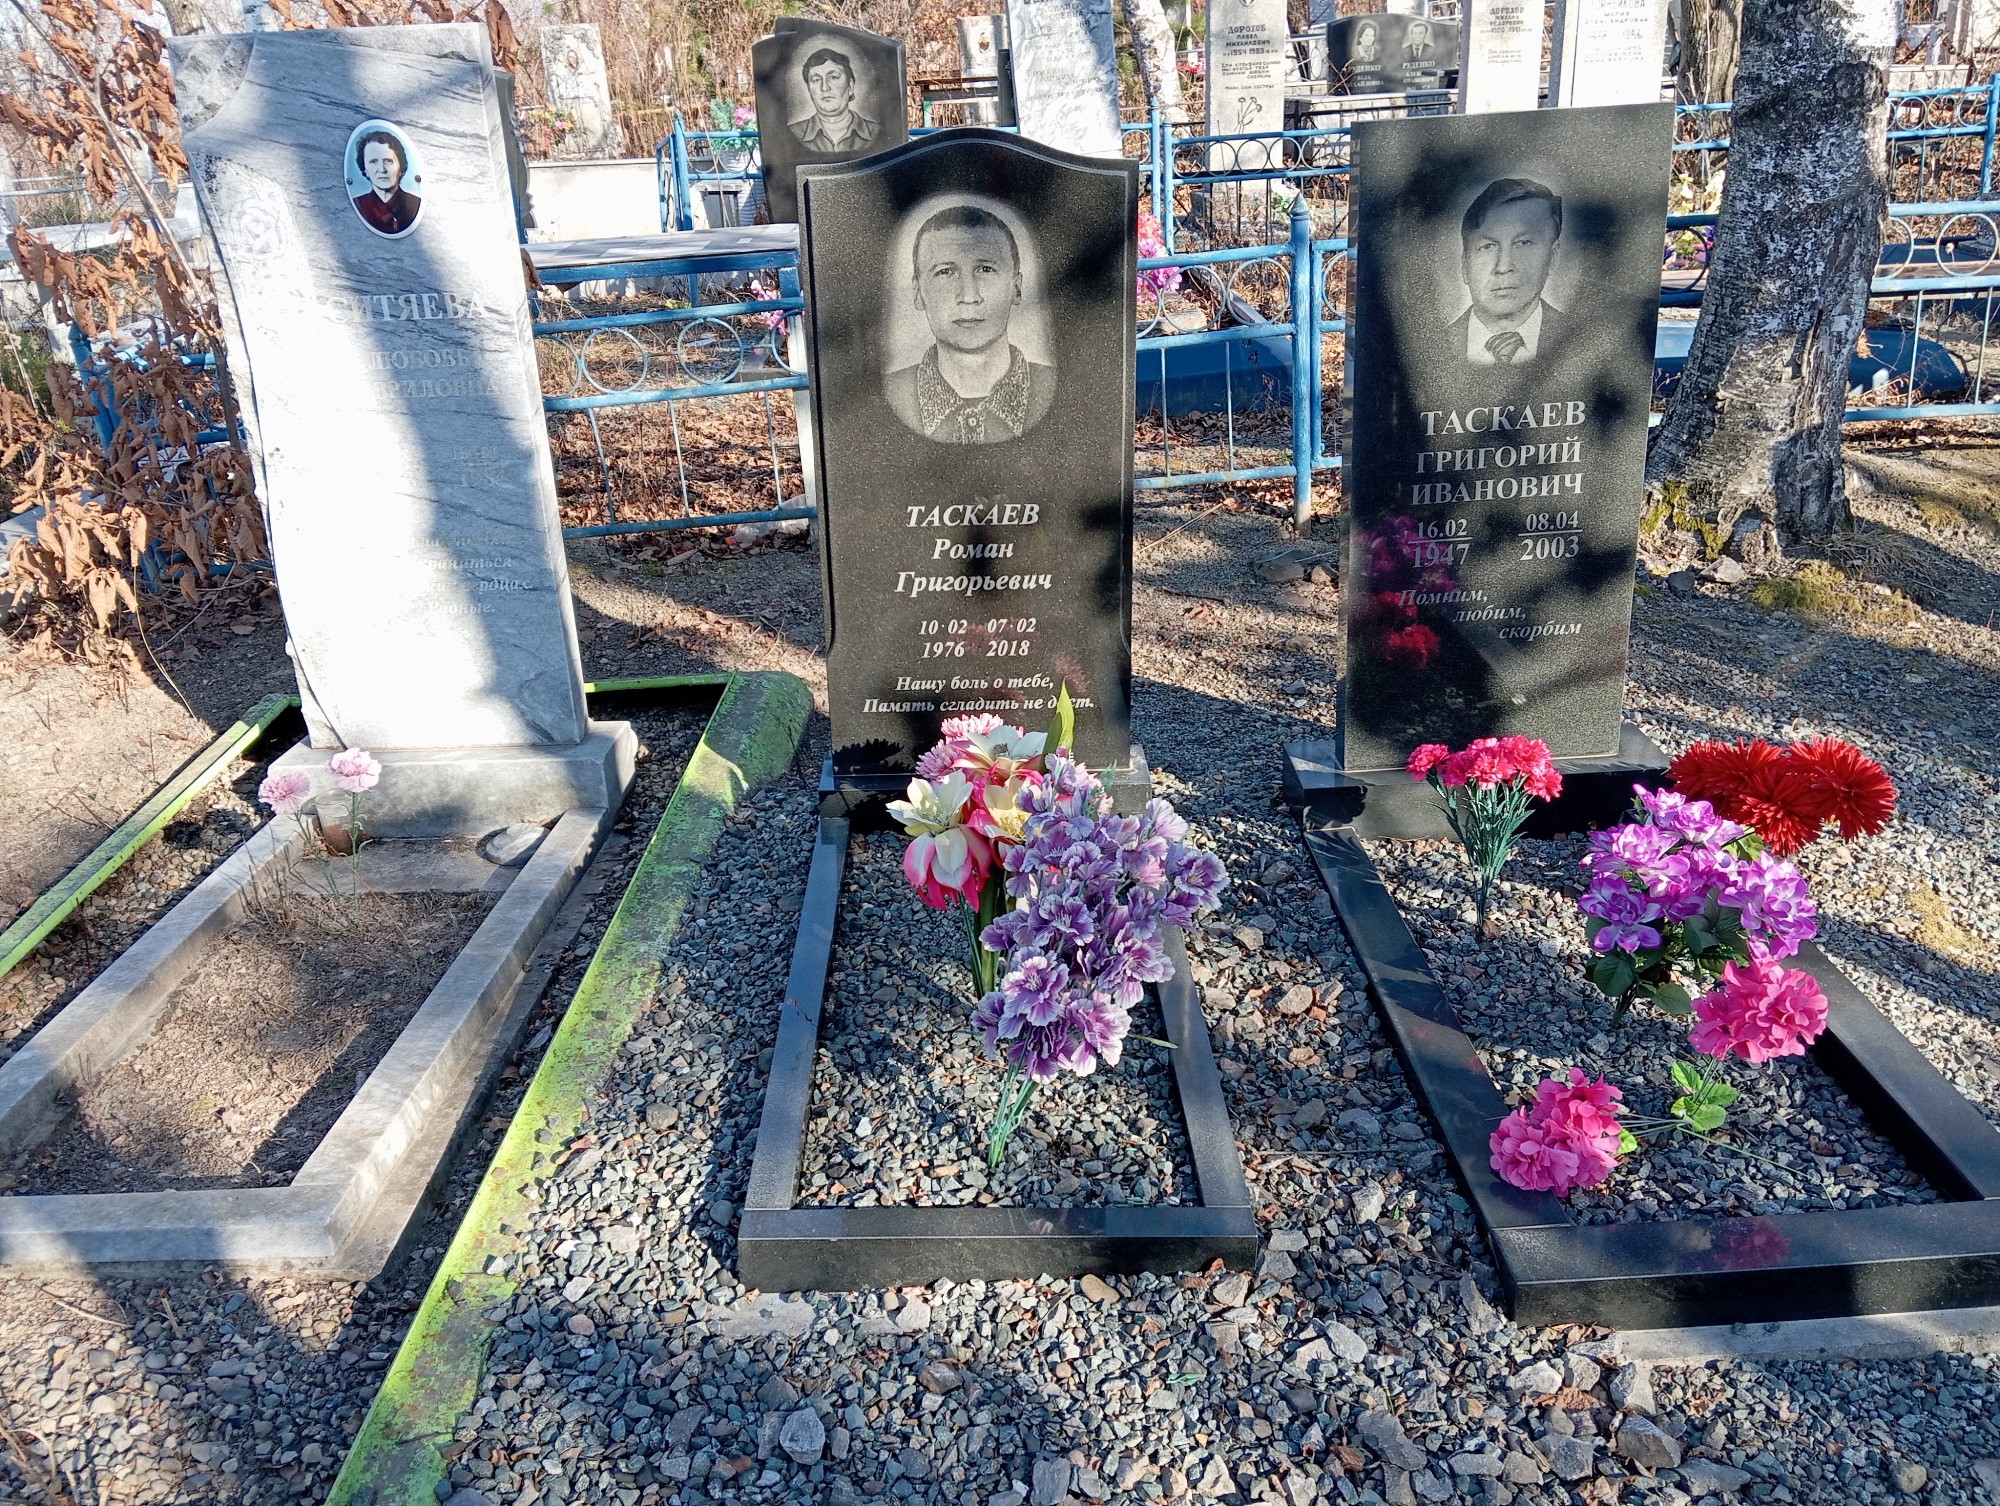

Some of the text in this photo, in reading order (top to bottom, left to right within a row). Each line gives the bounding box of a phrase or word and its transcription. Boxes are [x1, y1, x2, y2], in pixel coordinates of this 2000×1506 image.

[1228, 25, 1266, 35] ДОРОХОВ
[1402, 61, 1435, 69] РУДЕНКО
[326, 291, 492, 324] СИТЯЕВА
[370, 349, 468, 370] ЛЮБОВЬ
[1420, 400, 1586, 436] ТАСКАЕВ
[1415, 435, 1583, 474] ГРИГОРИЙ
[1410, 472, 1586, 506] ИВАНОВИЧ
[906, 503, 1040, 528] ТАСКАЕВ
[1416, 511, 1580, 539] 16.02 08.04
[931, 538, 1014, 560] Роман
[1412, 535, 1580, 568] 1947 2003
[894, 571, 1053, 598] Григорьевич
[1398, 588, 1488, 607] Помним,
[1452, 603, 1527, 623] любим,
[1499, 620, 1583, 642] скорбим
[921, 640, 1030, 658] 1976 2018
[895, 673, 1054, 694] Нашу боль о тебе,
[862, 696, 1095, 713] Память сгладить не дст.
